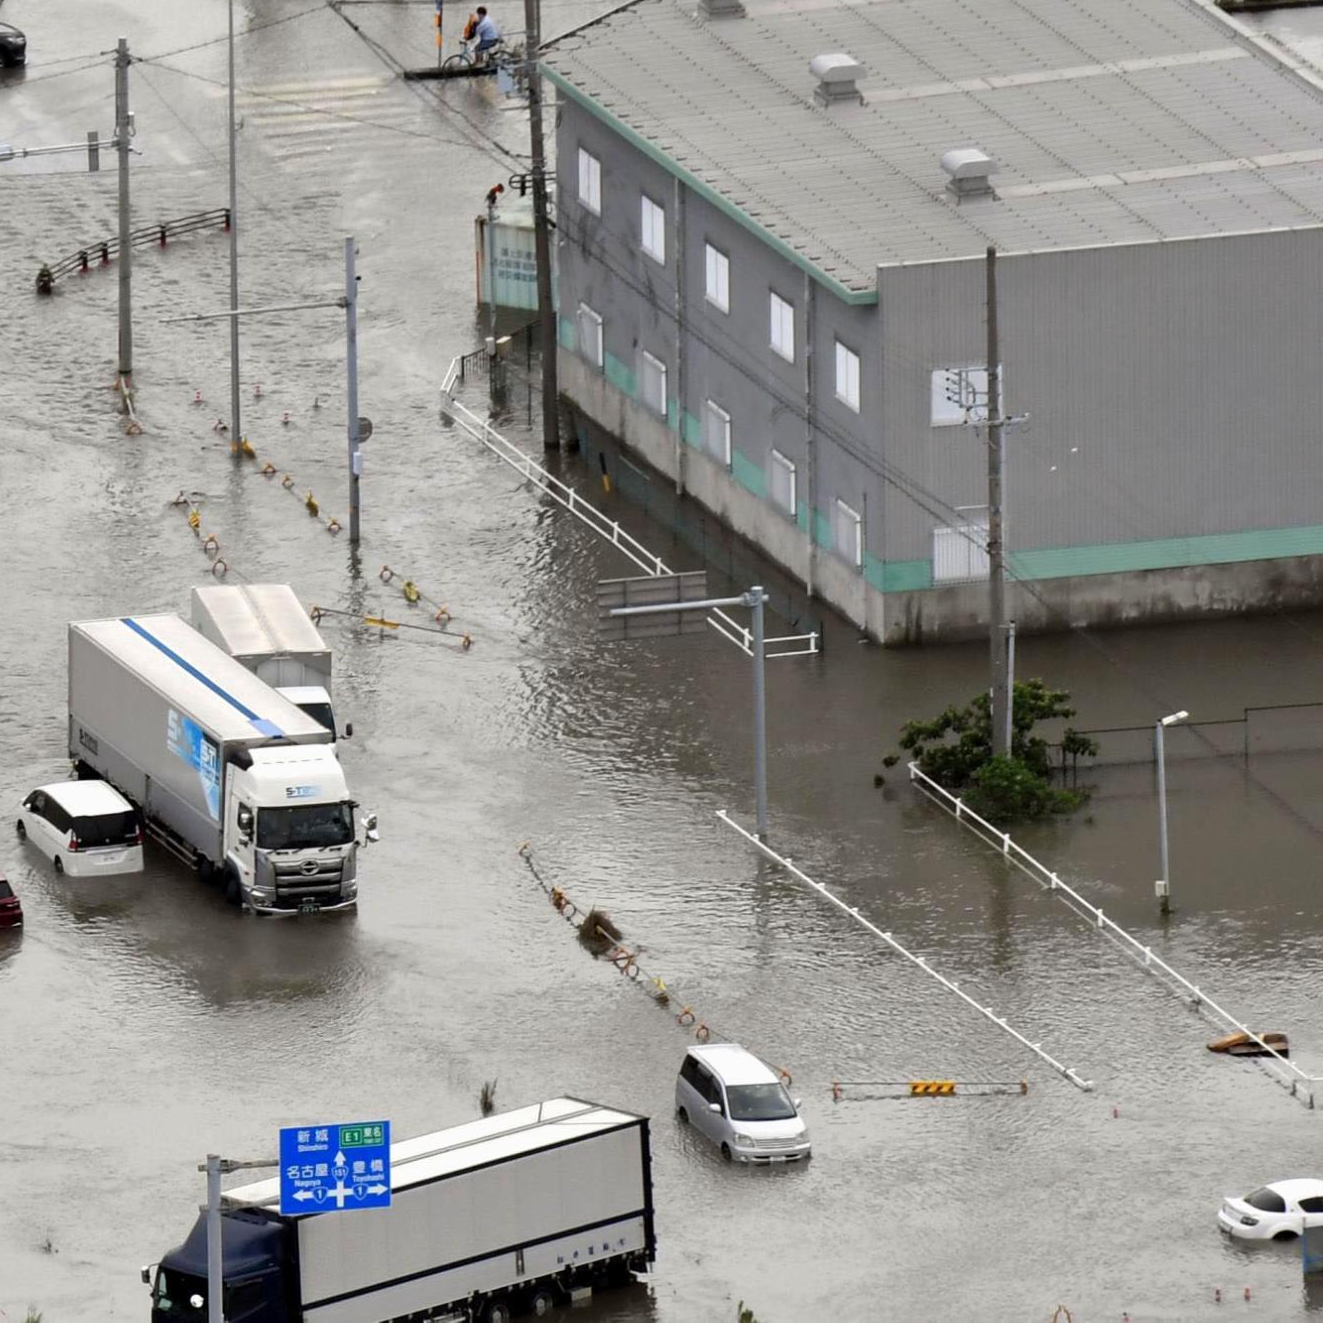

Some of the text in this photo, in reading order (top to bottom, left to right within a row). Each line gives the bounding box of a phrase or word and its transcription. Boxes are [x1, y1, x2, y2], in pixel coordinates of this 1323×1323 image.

[297, 1129, 329, 1144] 新城
[345, 1132, 359, 1142] E1
[363, 1127, 382, 1138] 東名
[297, 1144, 329, 1152] Shinshiro
[287, 1163, 329, 1179] 名古屋
[353, 1159, 384, 1174] 豊橋
[353, 1173, 385, 1182] Toyohashi
[294, 1179, 321, 1188] Nagoya
